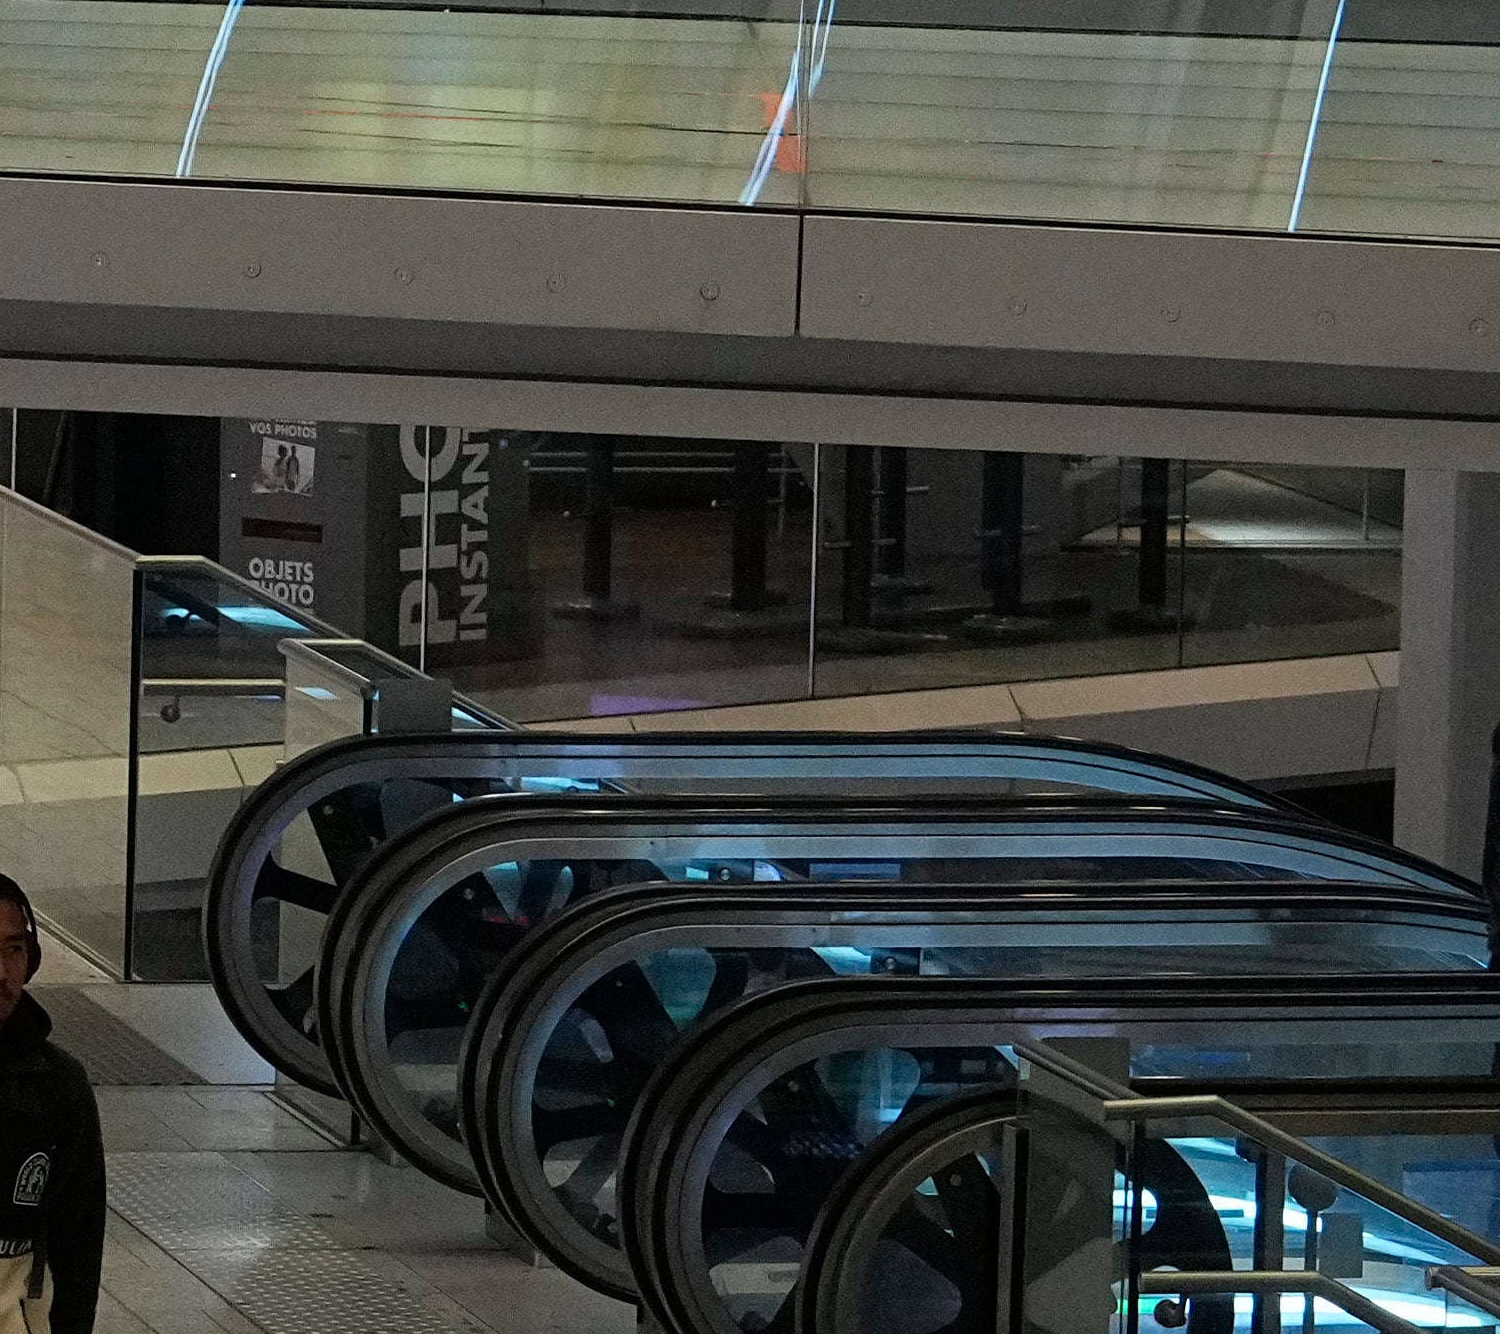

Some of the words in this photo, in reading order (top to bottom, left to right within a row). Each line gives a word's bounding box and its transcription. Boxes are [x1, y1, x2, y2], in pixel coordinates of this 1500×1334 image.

[250, 425, 272, 435] VOS
[274, 425, 318, 439] PHOTOS
[249, 556, 314, 584] OBJETS
